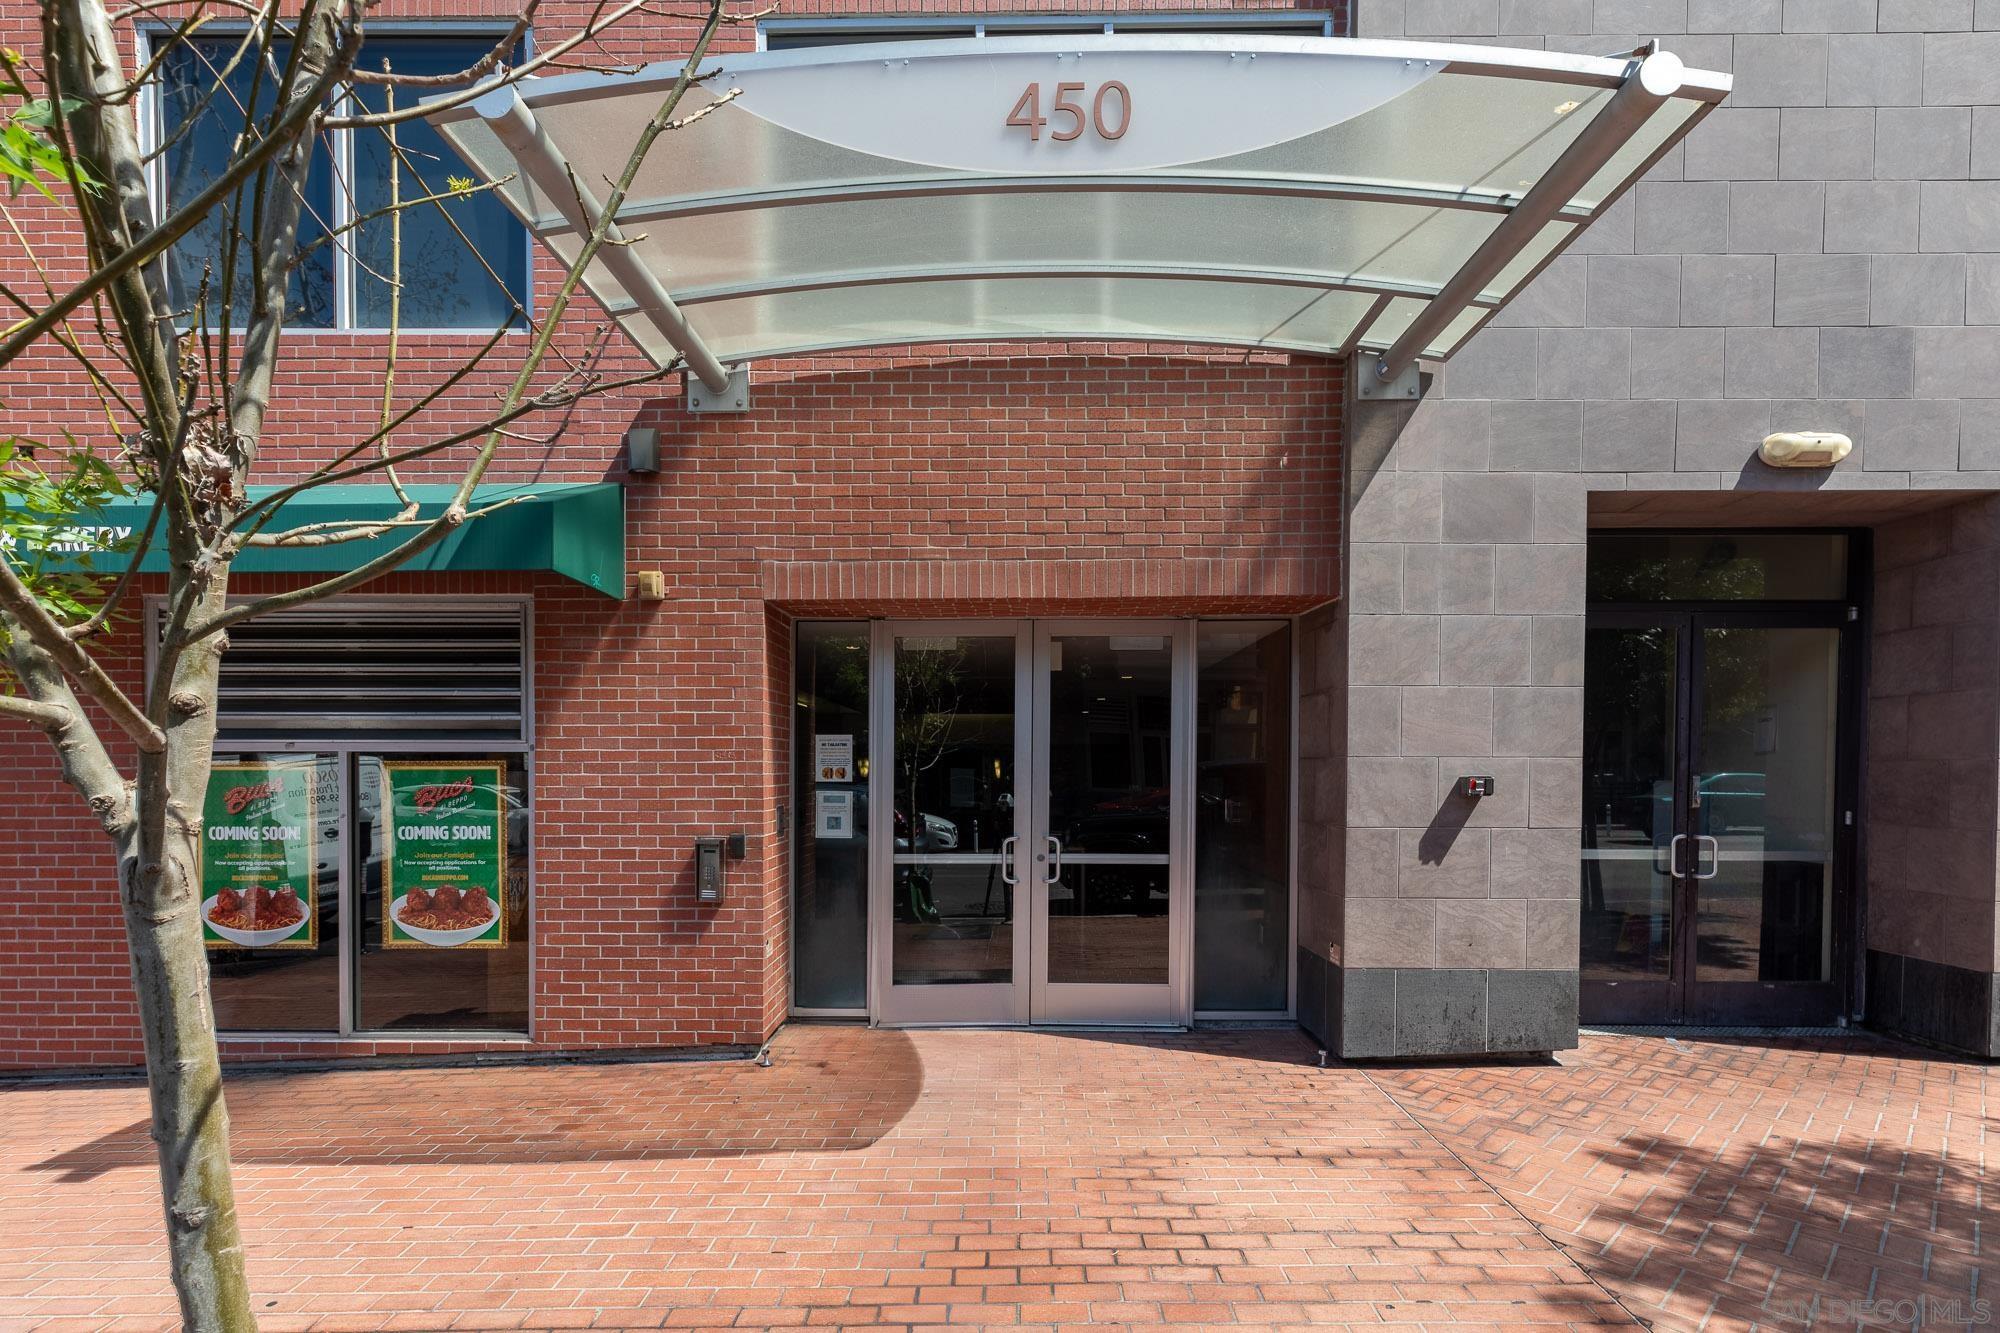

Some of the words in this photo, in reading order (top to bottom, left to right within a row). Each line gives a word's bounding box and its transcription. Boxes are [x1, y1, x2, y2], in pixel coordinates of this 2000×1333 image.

[1006, 80, 1132, 141] 450
[447, 795, 468, 808] BEPPO
[208, 826, 259, 841] COMING
[261, 826, 301, 841] SOON!
[397, 825, 449, 840] COMING
[452, 825, 492, 840] SOON!
[443, 852, 475, 860] Famiglia!
[227, 860, 254, 868] accepting
